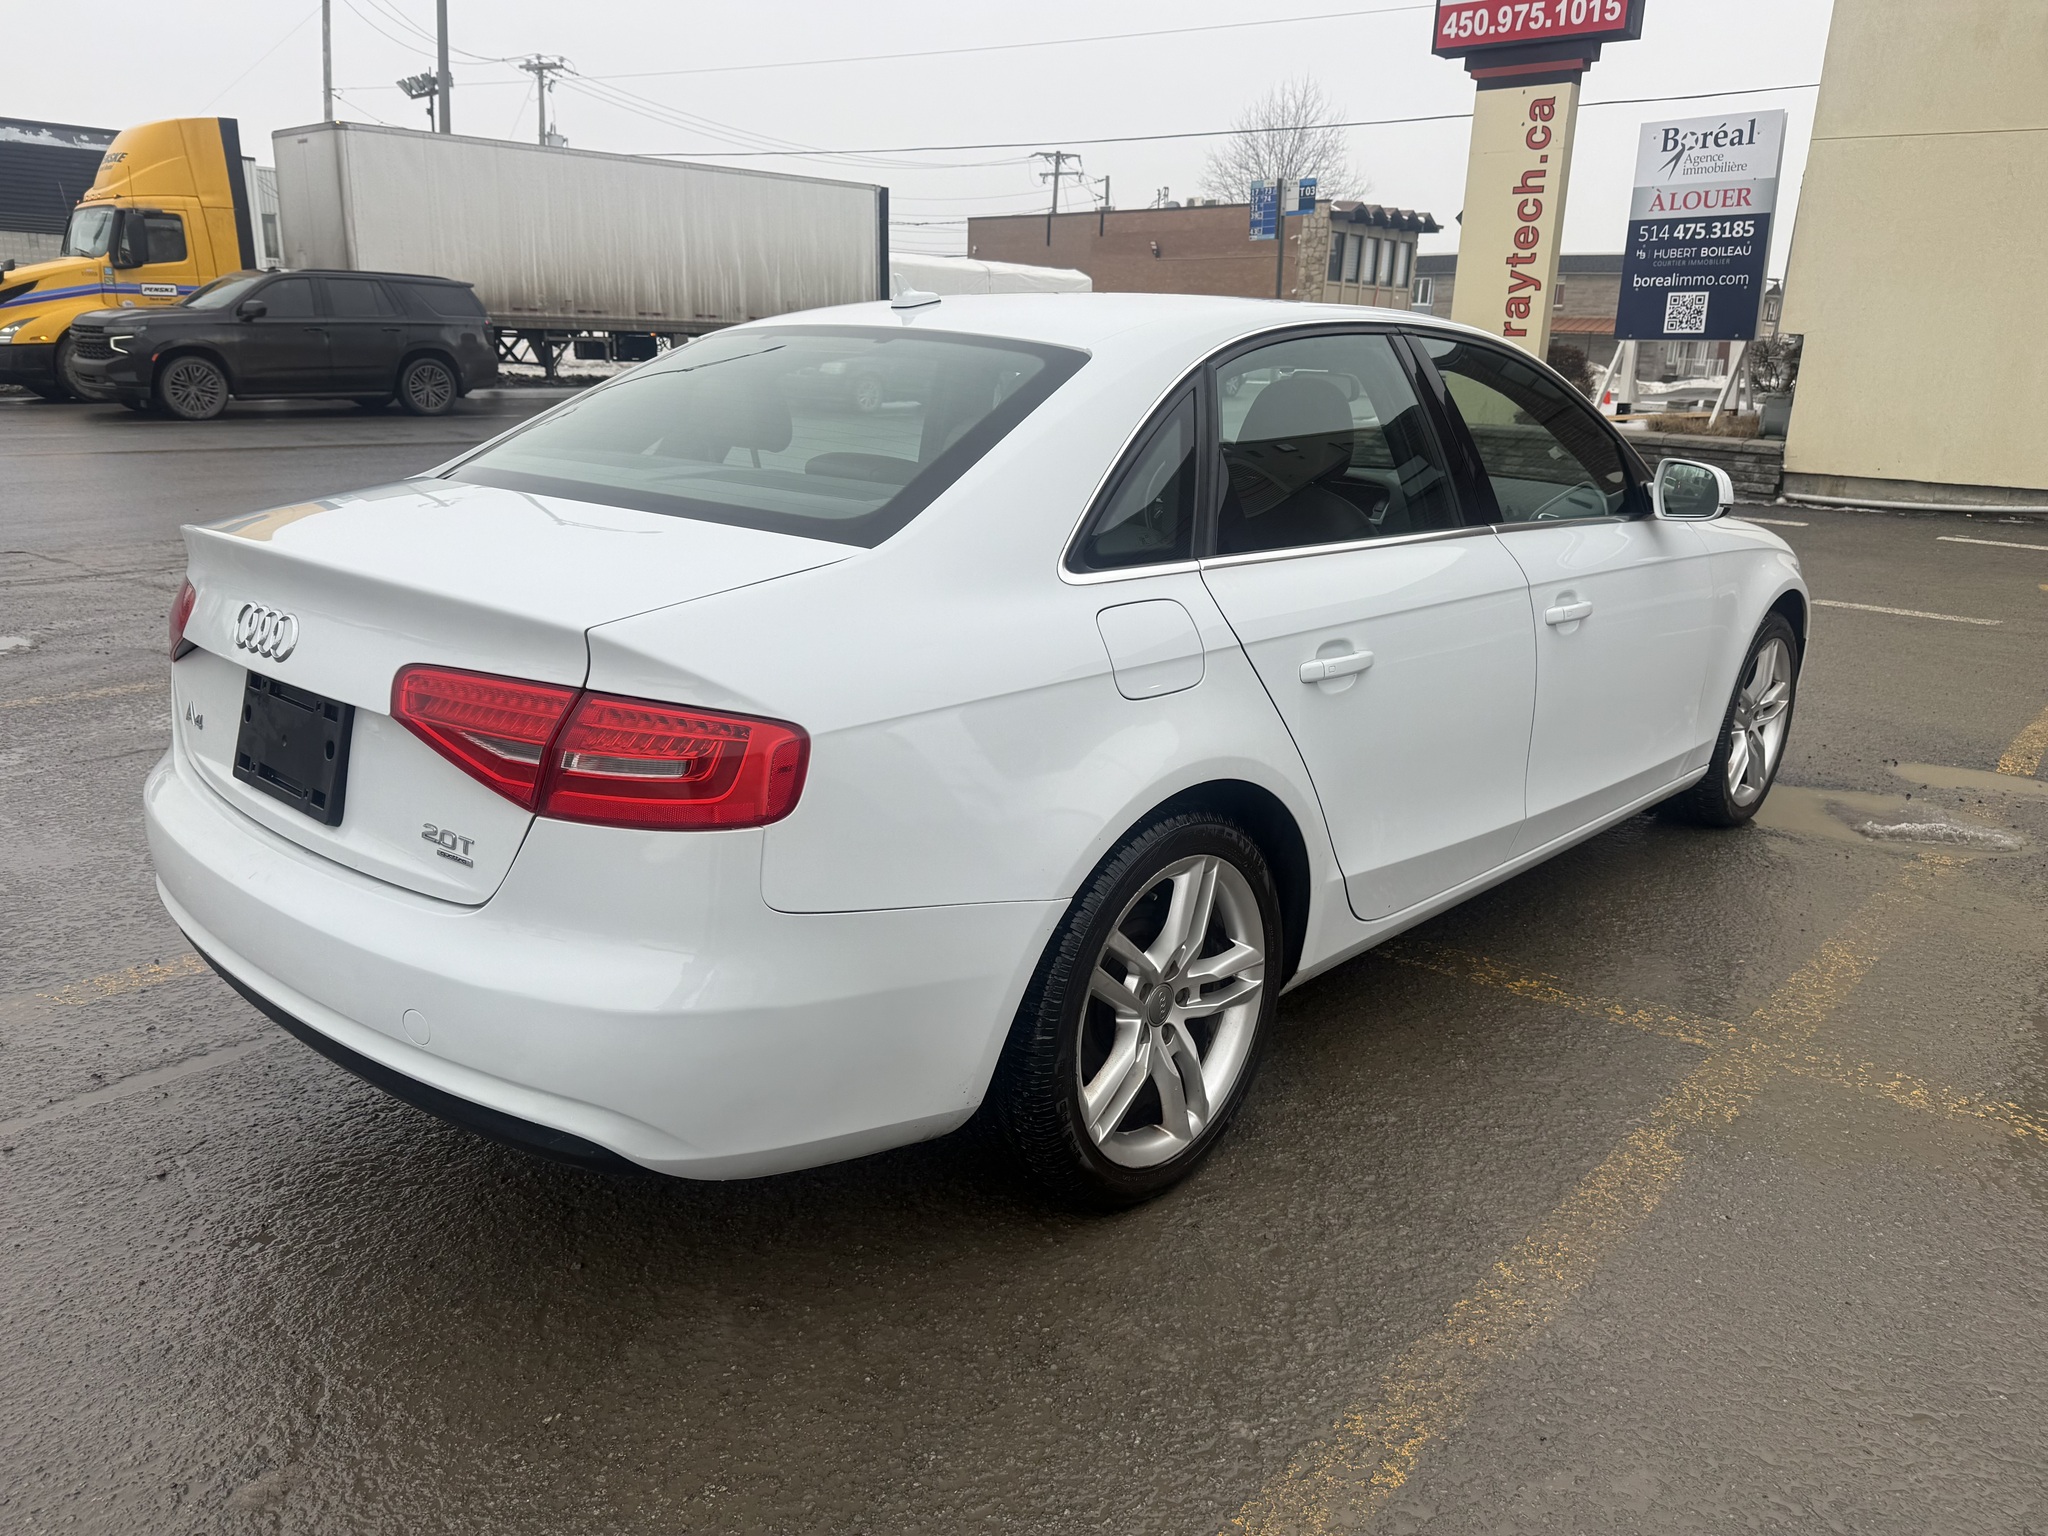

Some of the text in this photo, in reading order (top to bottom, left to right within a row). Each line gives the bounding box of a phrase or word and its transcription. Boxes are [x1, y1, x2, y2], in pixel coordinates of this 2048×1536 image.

[1442, 0, 1621, 39] 450.975.1015
[1661, 118, 1757, 153] Boréal
[1682, 162, 1748, 176] immobilière
[1683, 153, 1724, 167] Agence
[1648, 187, 1752, 212] À LOUER
[1503, 96, 1556, 337] raytech.ca
[1638, 220, 1755, 242] 514 475.3185
[1653, 247, 1697, 259] HUBERT
[1700, 245, 1752, 257] BOILEAU
[1688, 258, 1730, 266] IMMOBILIER
[1633, 273, 1749, 288] borealimmo.com
[185, 701, 204, 730] A4
